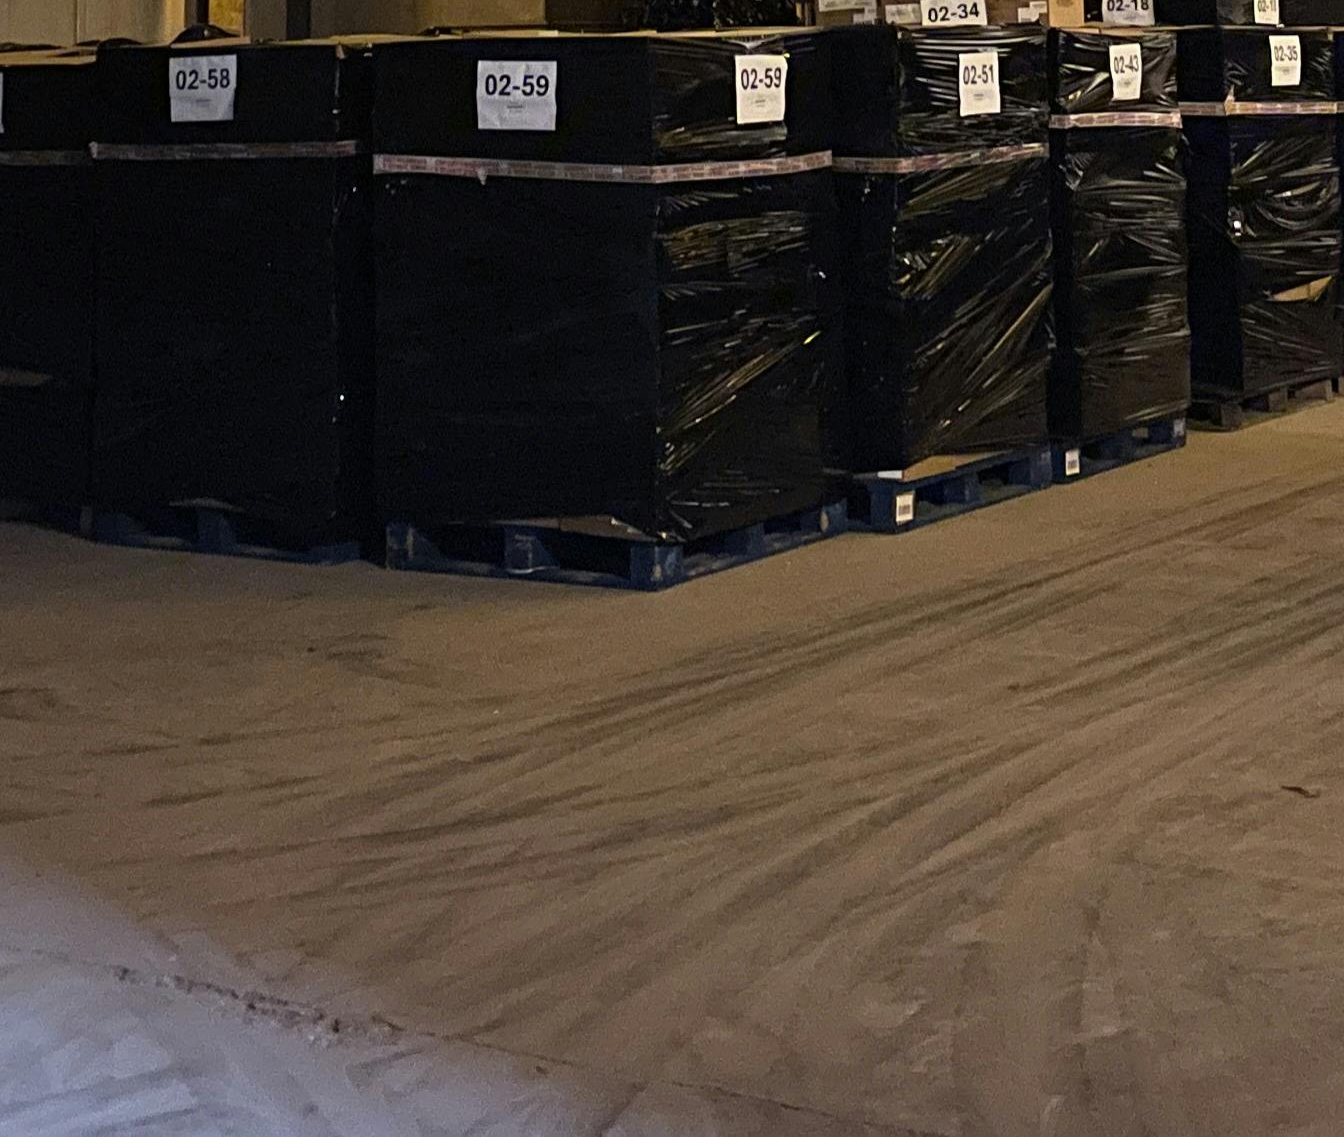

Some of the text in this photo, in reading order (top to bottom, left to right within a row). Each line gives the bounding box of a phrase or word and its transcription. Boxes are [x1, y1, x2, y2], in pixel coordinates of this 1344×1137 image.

[927, 1, 980, 23] 02-34
[962, 64, 995, 85] 02-51
[1113, 54, 1140, 75] 02-43
[175, 67, 231, 90] 02-58
[484, 74, 550, 97] 02-59
[740, 66, 783, 91] 02-59
